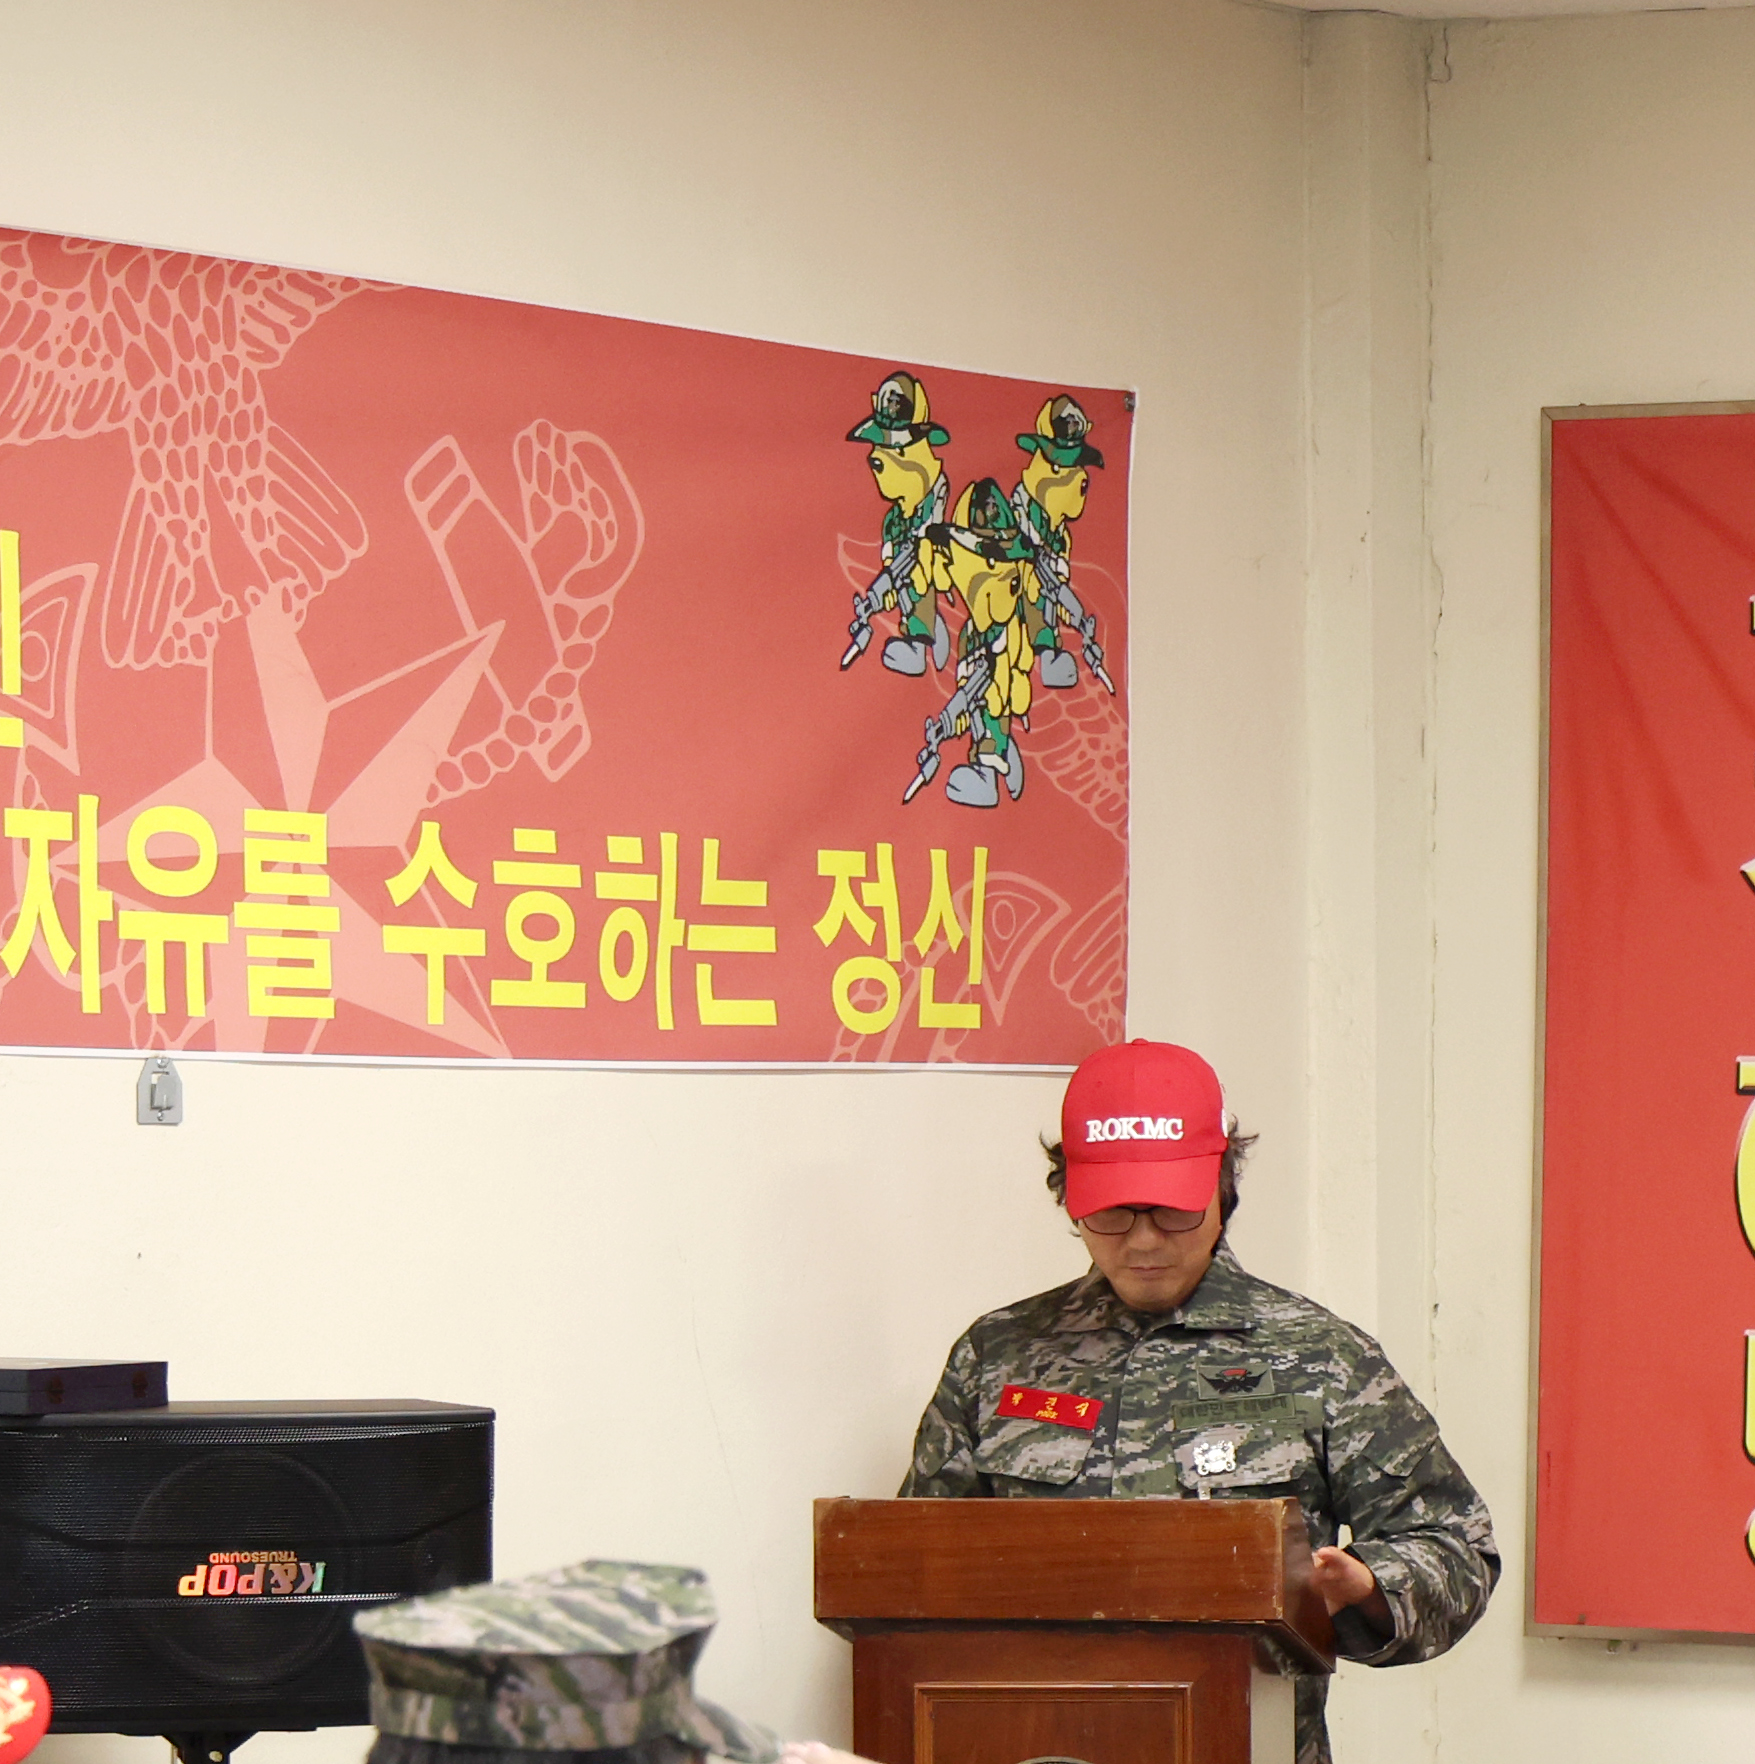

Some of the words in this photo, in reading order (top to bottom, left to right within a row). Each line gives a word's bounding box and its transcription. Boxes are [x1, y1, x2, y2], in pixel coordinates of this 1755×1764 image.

[0, 793, 342, 1020] 자유를
[381, 819, 779, 1031] 수호하는
[812, 842, 990, 1036] 정신
[1085, 1117, 1184, 1142] ROKMC
[209, 1550, 298, 1564] TRUESOUND
[178, 1561, 326, 1597] K&POP
